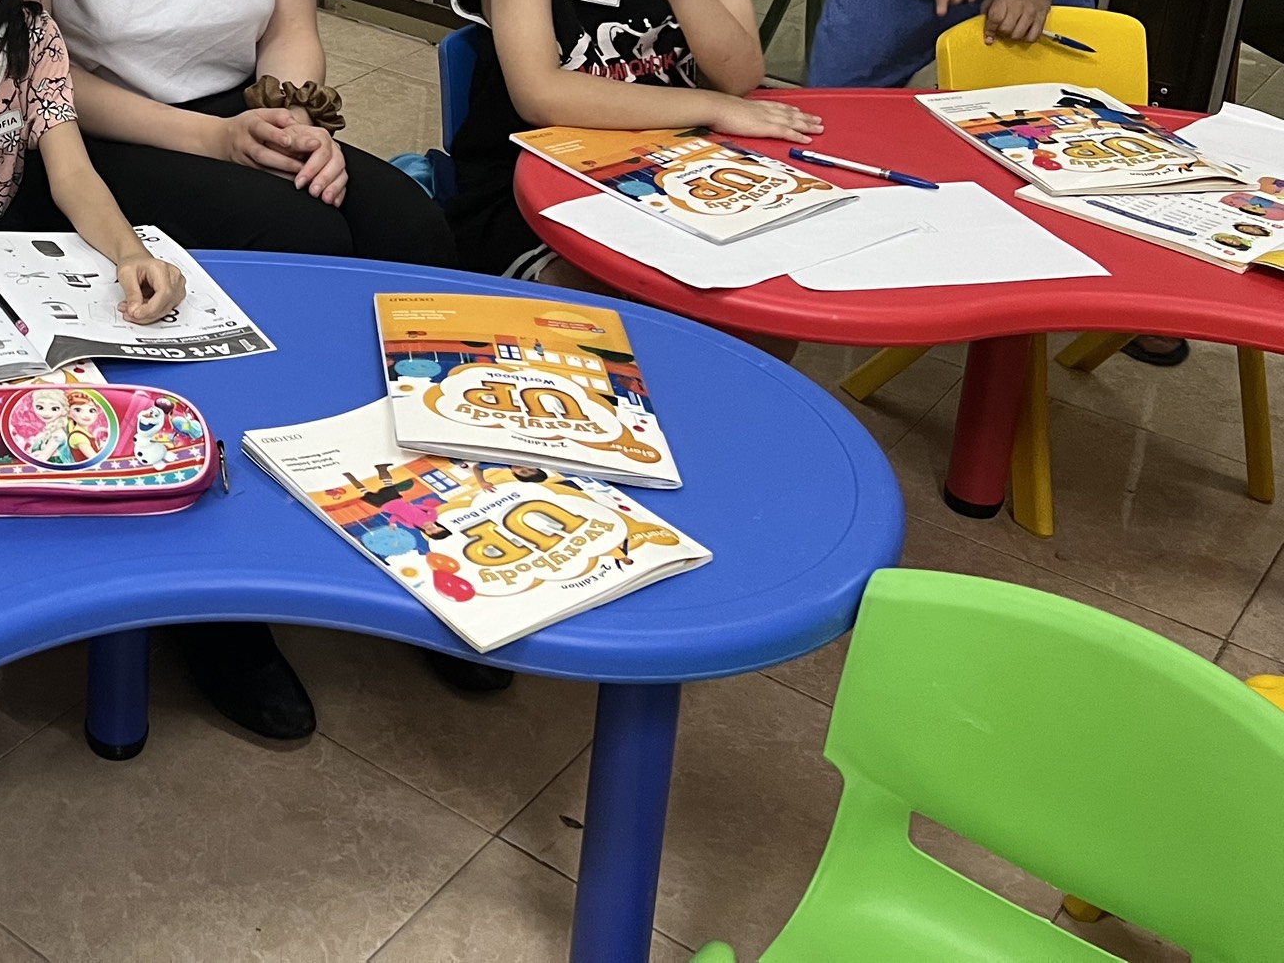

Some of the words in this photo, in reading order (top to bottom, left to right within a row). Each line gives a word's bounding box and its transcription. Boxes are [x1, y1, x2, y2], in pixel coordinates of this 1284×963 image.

[1062, 137, 1168, 158] UP
[683, 168, 769, 200] UP
[120, 345, 186, 359] Class
[189, 343, 231, 356] Art
[239, 338, 257, 352] 1
[485, 372, 556, 386] Workbook
[463, 380, 591, 421] UP
[454, 403, 609, 435] Everybody
[261, 433, 303, 444] OXFORD
[511, 434, 548, 447] Edition
[608, 443, 657, 459] Starter
[479, 492, 521, 515] Student
[449, 510, 480, 525] Book
[460, 500, 589, 566] UP
[477, 518, 615, 586] Everybody
[560, 575, 597, 590] Edition
